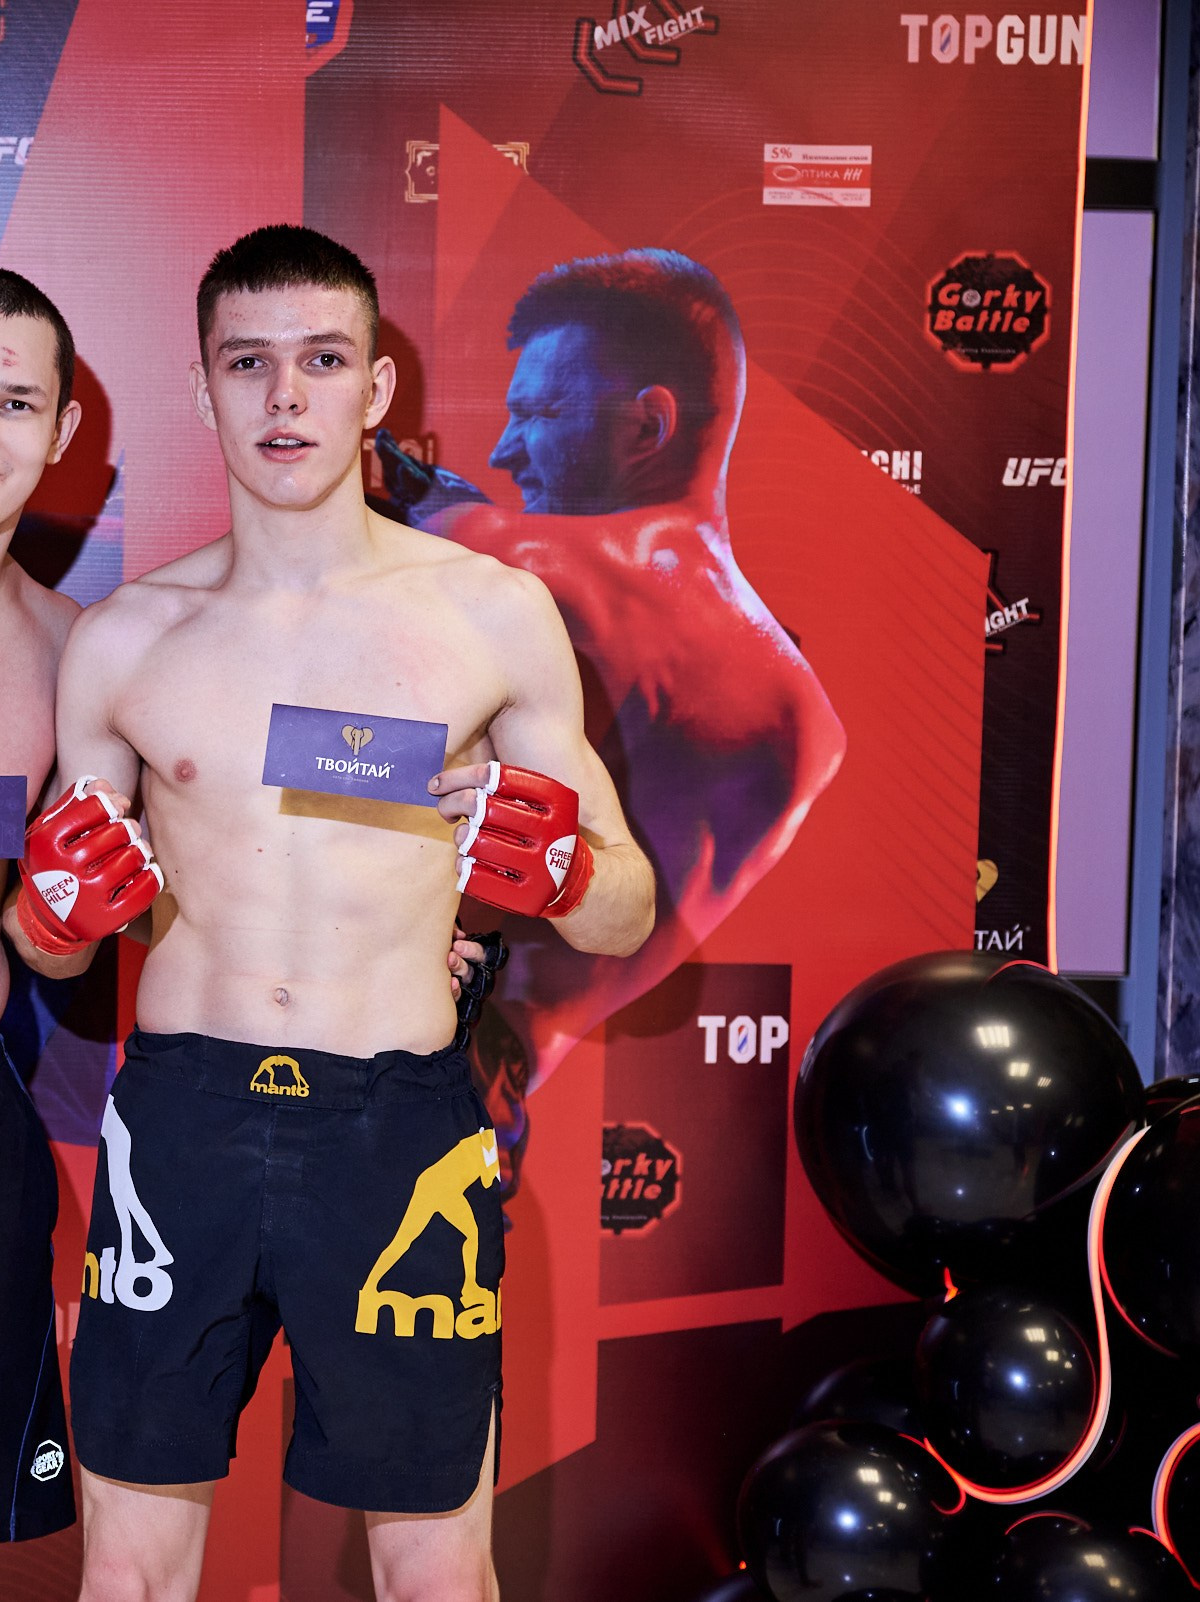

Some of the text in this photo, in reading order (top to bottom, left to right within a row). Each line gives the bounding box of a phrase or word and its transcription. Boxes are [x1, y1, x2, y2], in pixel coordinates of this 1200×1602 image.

[594, 6, 651, 50] MIX
[645, 6, 704, 45] FIGHT
[900, 14, 1087, 65] TOPGUN
[938, 282, 1042, 314] Gorky
[933, 309, 1030, 334] Battle
[315, 756, 392, 779] ТВОЙТАЙ
[41, 875, 75, 898] GREEN
[46, 888, 75, 905] HILL
[698, 1015, 789, 1064] TOP
[249, 1081, 311, 1098] manto
